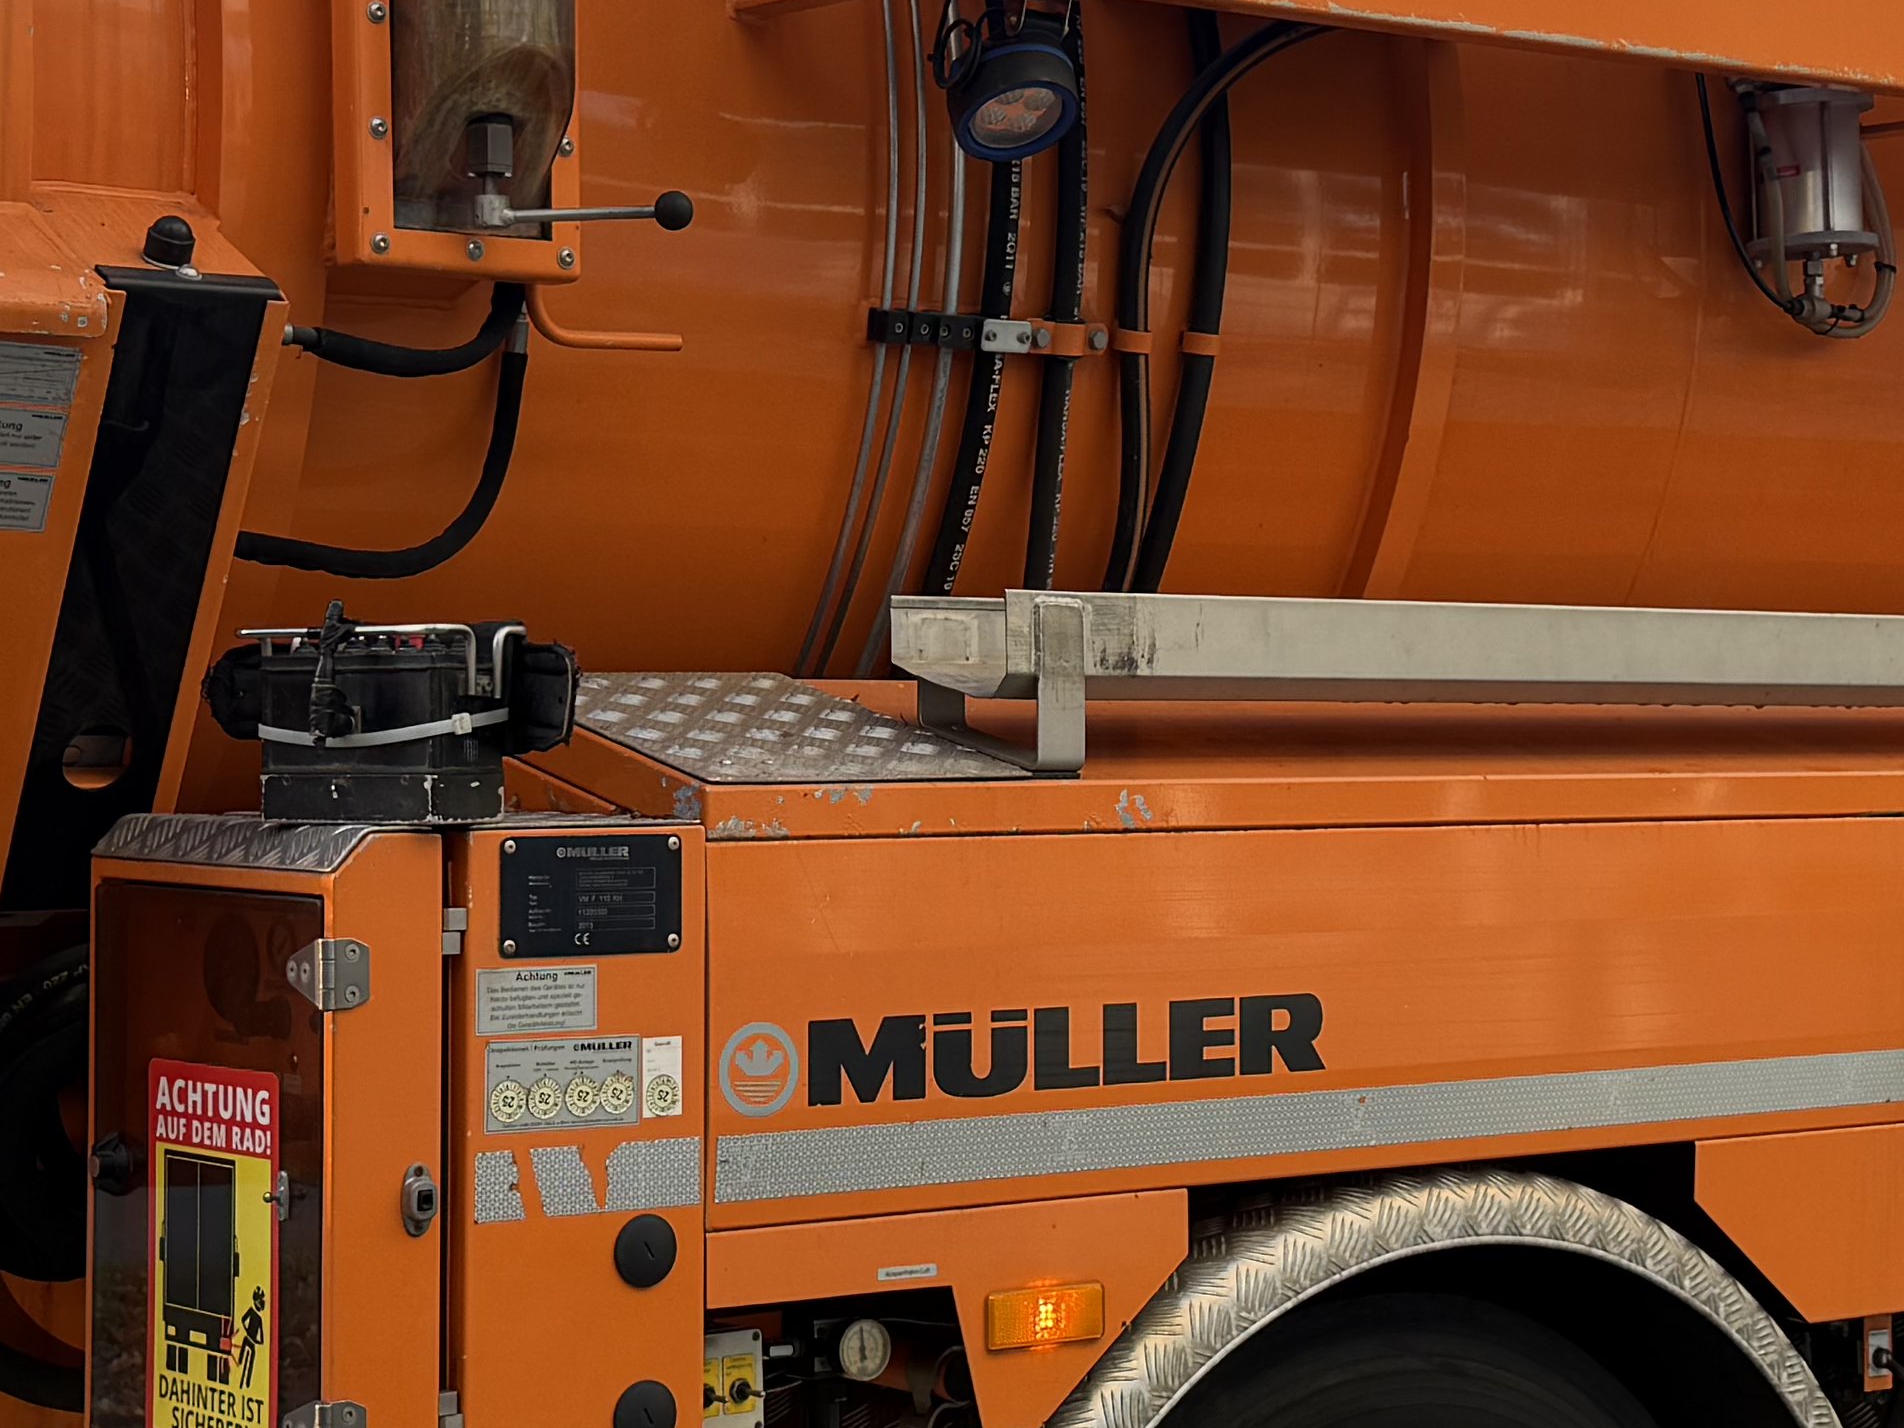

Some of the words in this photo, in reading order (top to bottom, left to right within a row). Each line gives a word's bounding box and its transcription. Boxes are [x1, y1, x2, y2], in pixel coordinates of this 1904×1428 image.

[516, 972, 558, 981] Achtung
[807, 991, 1326, 1107] MÜLLER
[538, 1091, 552, 1105] 25
[577, 1089, 590, 1102] 25
[610, 1087, 624, 1100] 25
[656, 1089, 670, 1102] 25
[156, 1076, 270, 1125] ACHTUNG
[502, 1095, 515, 1108] 25
[156, 1115, 187, 1141] AUF
[192, 1120, 226, 1148] DEM
[232, 1126, 271, 1155] RAD!
[159, 1374, 236, 1418] DAHINTER
[242, 1395, 264, 1424] IST
